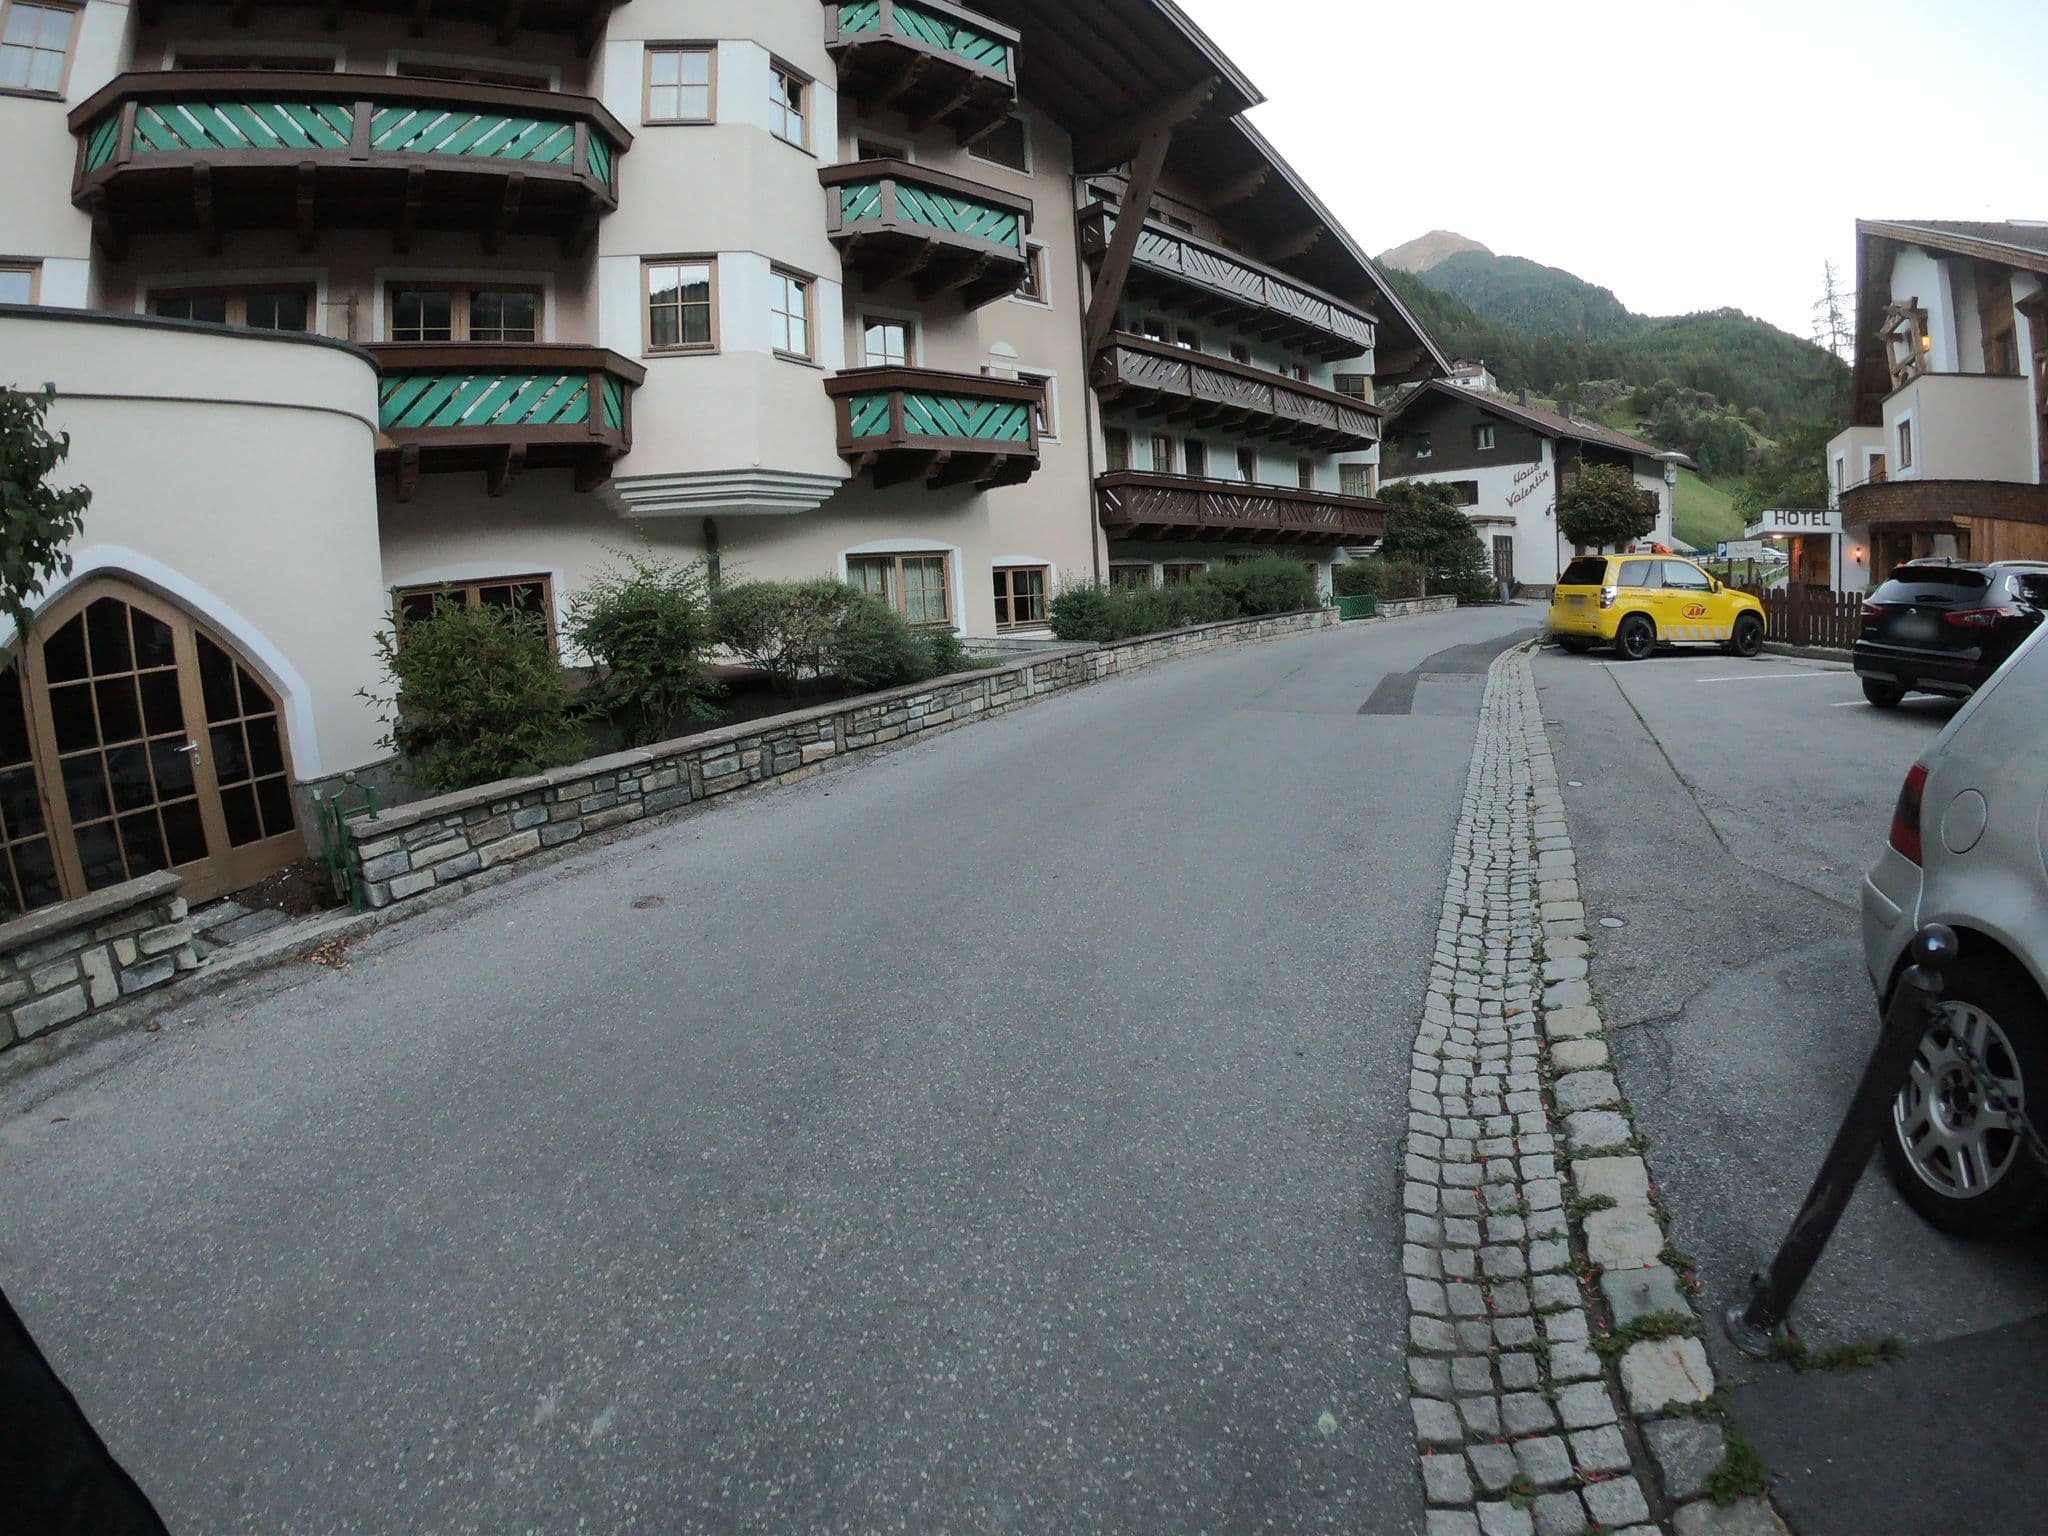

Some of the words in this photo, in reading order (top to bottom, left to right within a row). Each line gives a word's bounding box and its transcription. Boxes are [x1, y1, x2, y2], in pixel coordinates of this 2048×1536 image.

[1514, 460, 1540, 486] Haus
[1506, 470, 1549, 507] Valentin
[1774, 511, 1831, 526] HOTEL
[1718, 543, 1726, 556] P
